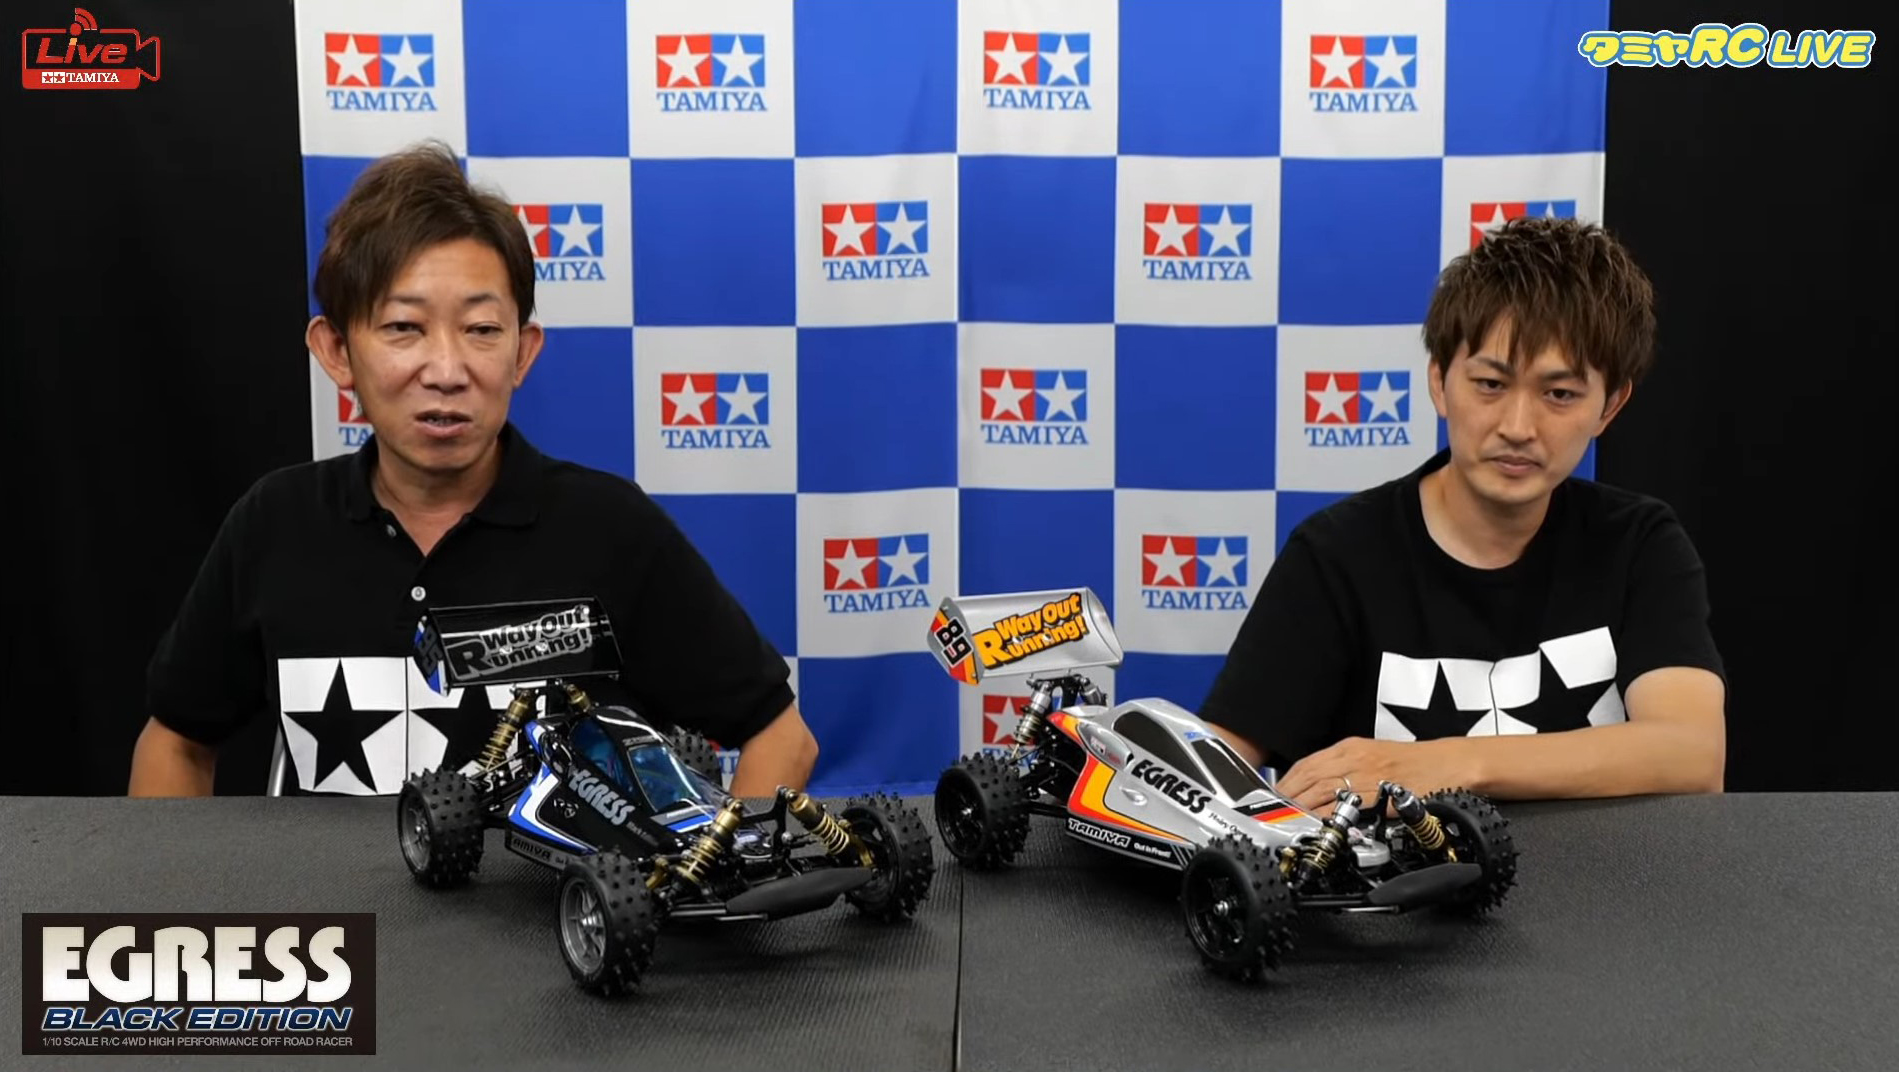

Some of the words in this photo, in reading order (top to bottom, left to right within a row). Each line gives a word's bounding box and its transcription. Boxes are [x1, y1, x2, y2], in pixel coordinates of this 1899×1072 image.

[327, 90, 437, 112] TAMIYA
[657, 91, 767, 112] TAMIYA
[984, 88, 1091, 110] TAMIYA
[1309, 91, 1418, 112] TAMIYA
[535, 260, 606, 281] MIYA
[823, 258, 930, 281] TAMIYA
[1143, 259, 1252, 280] TAMIYA
[661, 428, 771, 449] TAMIYA
[981, 424, 1089, 446] TAMIYA
[1304, 426, 1411, 447] TAMIYA
[824, 589, 931, 614] TAMIYA
[1142, 589, 1248, 611] TAMIYA
[994, 609, 1043, 641] Way
[1042, 592, 1082, 624] Out
[935, 616, 973, 667] 89
[971, 615, 1090, 669] Running!
[445, 627, 592, 680] Running!
[569, 768, 636, 826] EGRESS
[1131, 759, 1212, 814] EGRESS
[1068, 818, 1131, 848] TAMIYA
[511, 836, 552, 860] AMIYA
